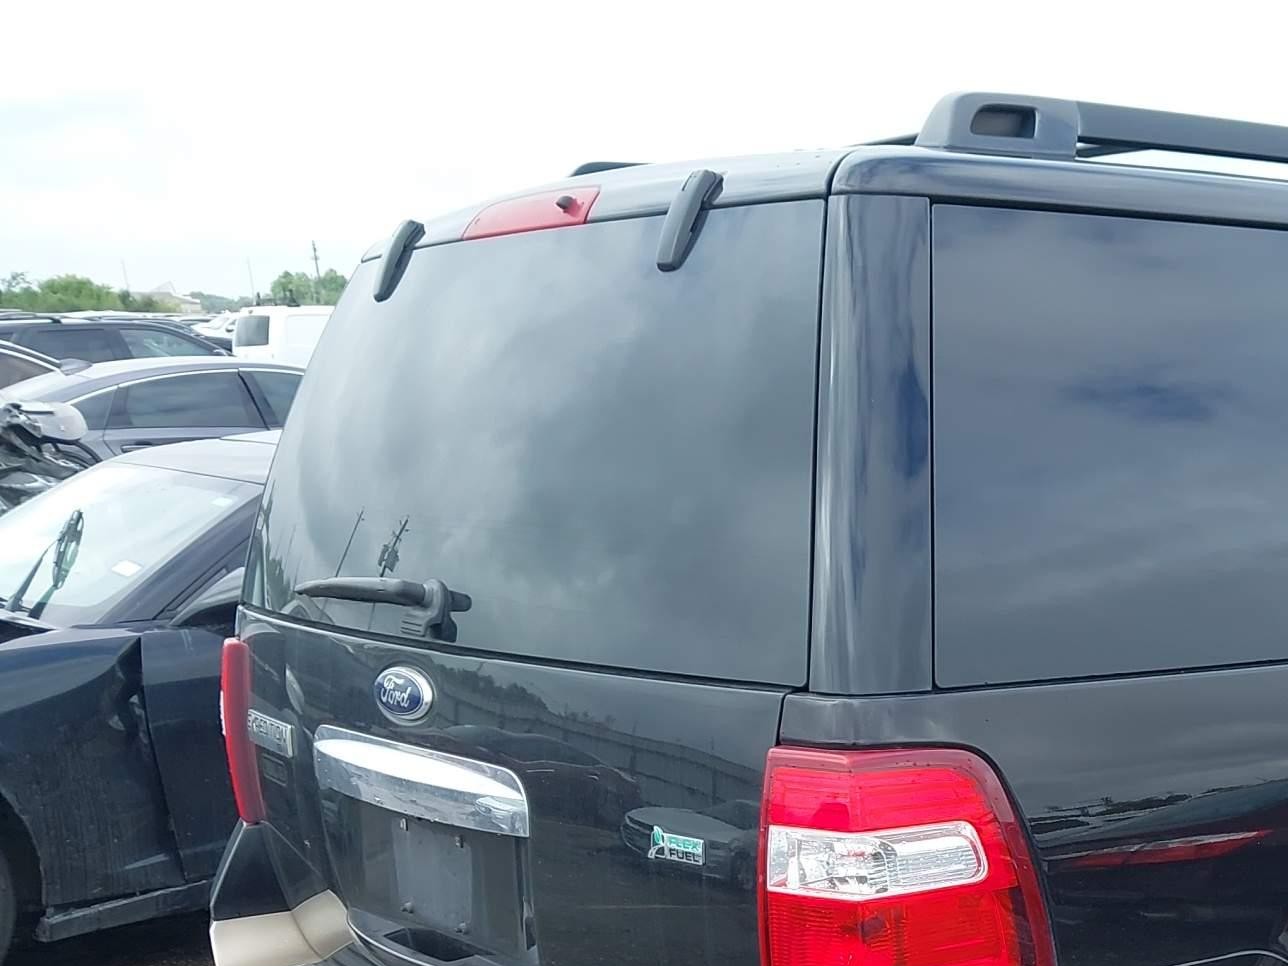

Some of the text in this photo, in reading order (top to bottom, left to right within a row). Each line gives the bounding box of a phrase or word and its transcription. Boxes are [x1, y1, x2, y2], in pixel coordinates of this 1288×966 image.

[380, 674, 413, 708] Ford
[668, 836, 700, 852] FLEX
[669, 847, 701, 864] FUEL
